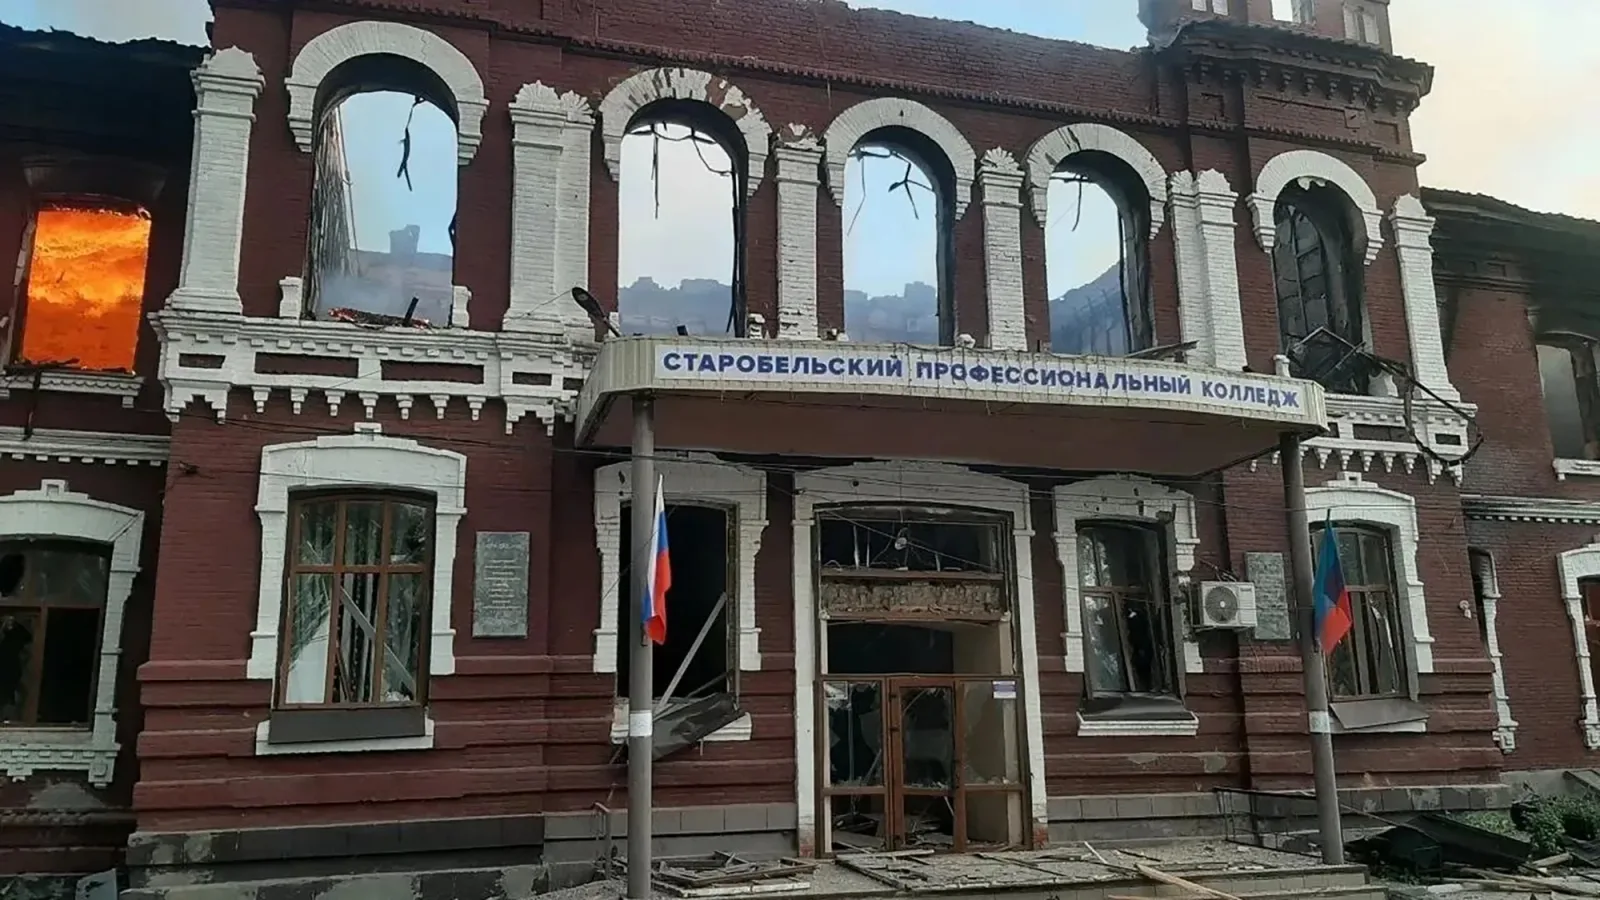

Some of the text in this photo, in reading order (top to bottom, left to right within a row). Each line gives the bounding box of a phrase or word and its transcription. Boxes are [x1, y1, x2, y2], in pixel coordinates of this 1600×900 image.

[663, 352, 1300, 409] СТАРОБЕЛЬСКИЙ ПРОФЕССИОНАЛЬНЫЙ КОЛЛЕДЖ
